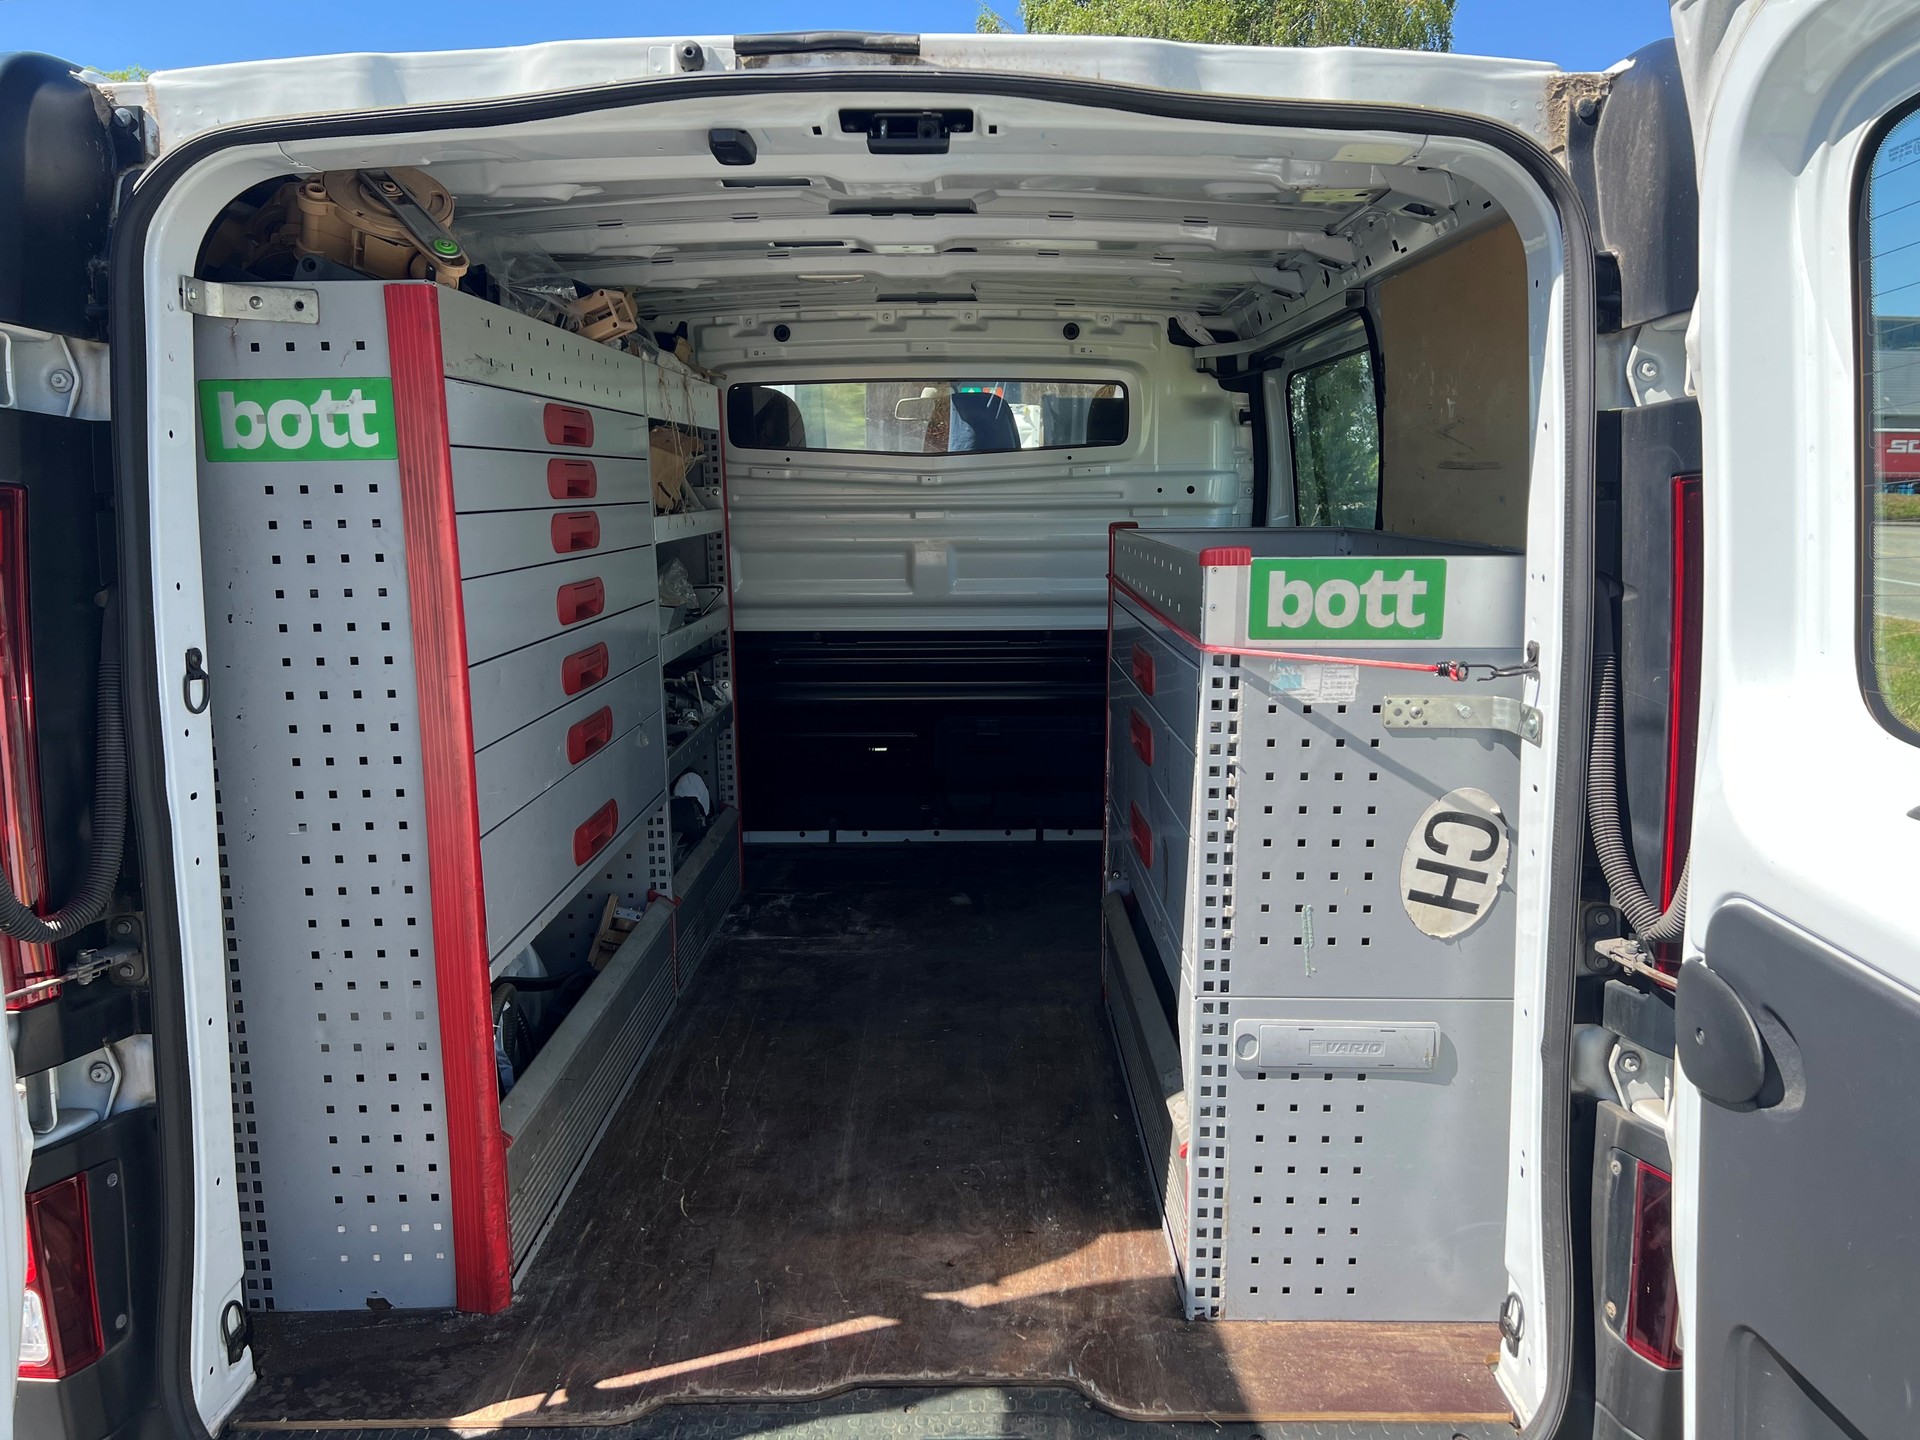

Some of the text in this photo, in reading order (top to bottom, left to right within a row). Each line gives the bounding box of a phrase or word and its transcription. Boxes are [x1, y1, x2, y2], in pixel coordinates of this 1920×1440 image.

[218, 389, 379, 450] bott
[1267, 570, 1427, 628] bott
[1407, 811, 1500, 916] CH
[1326, 1042, 1383, 1055] VARIO
